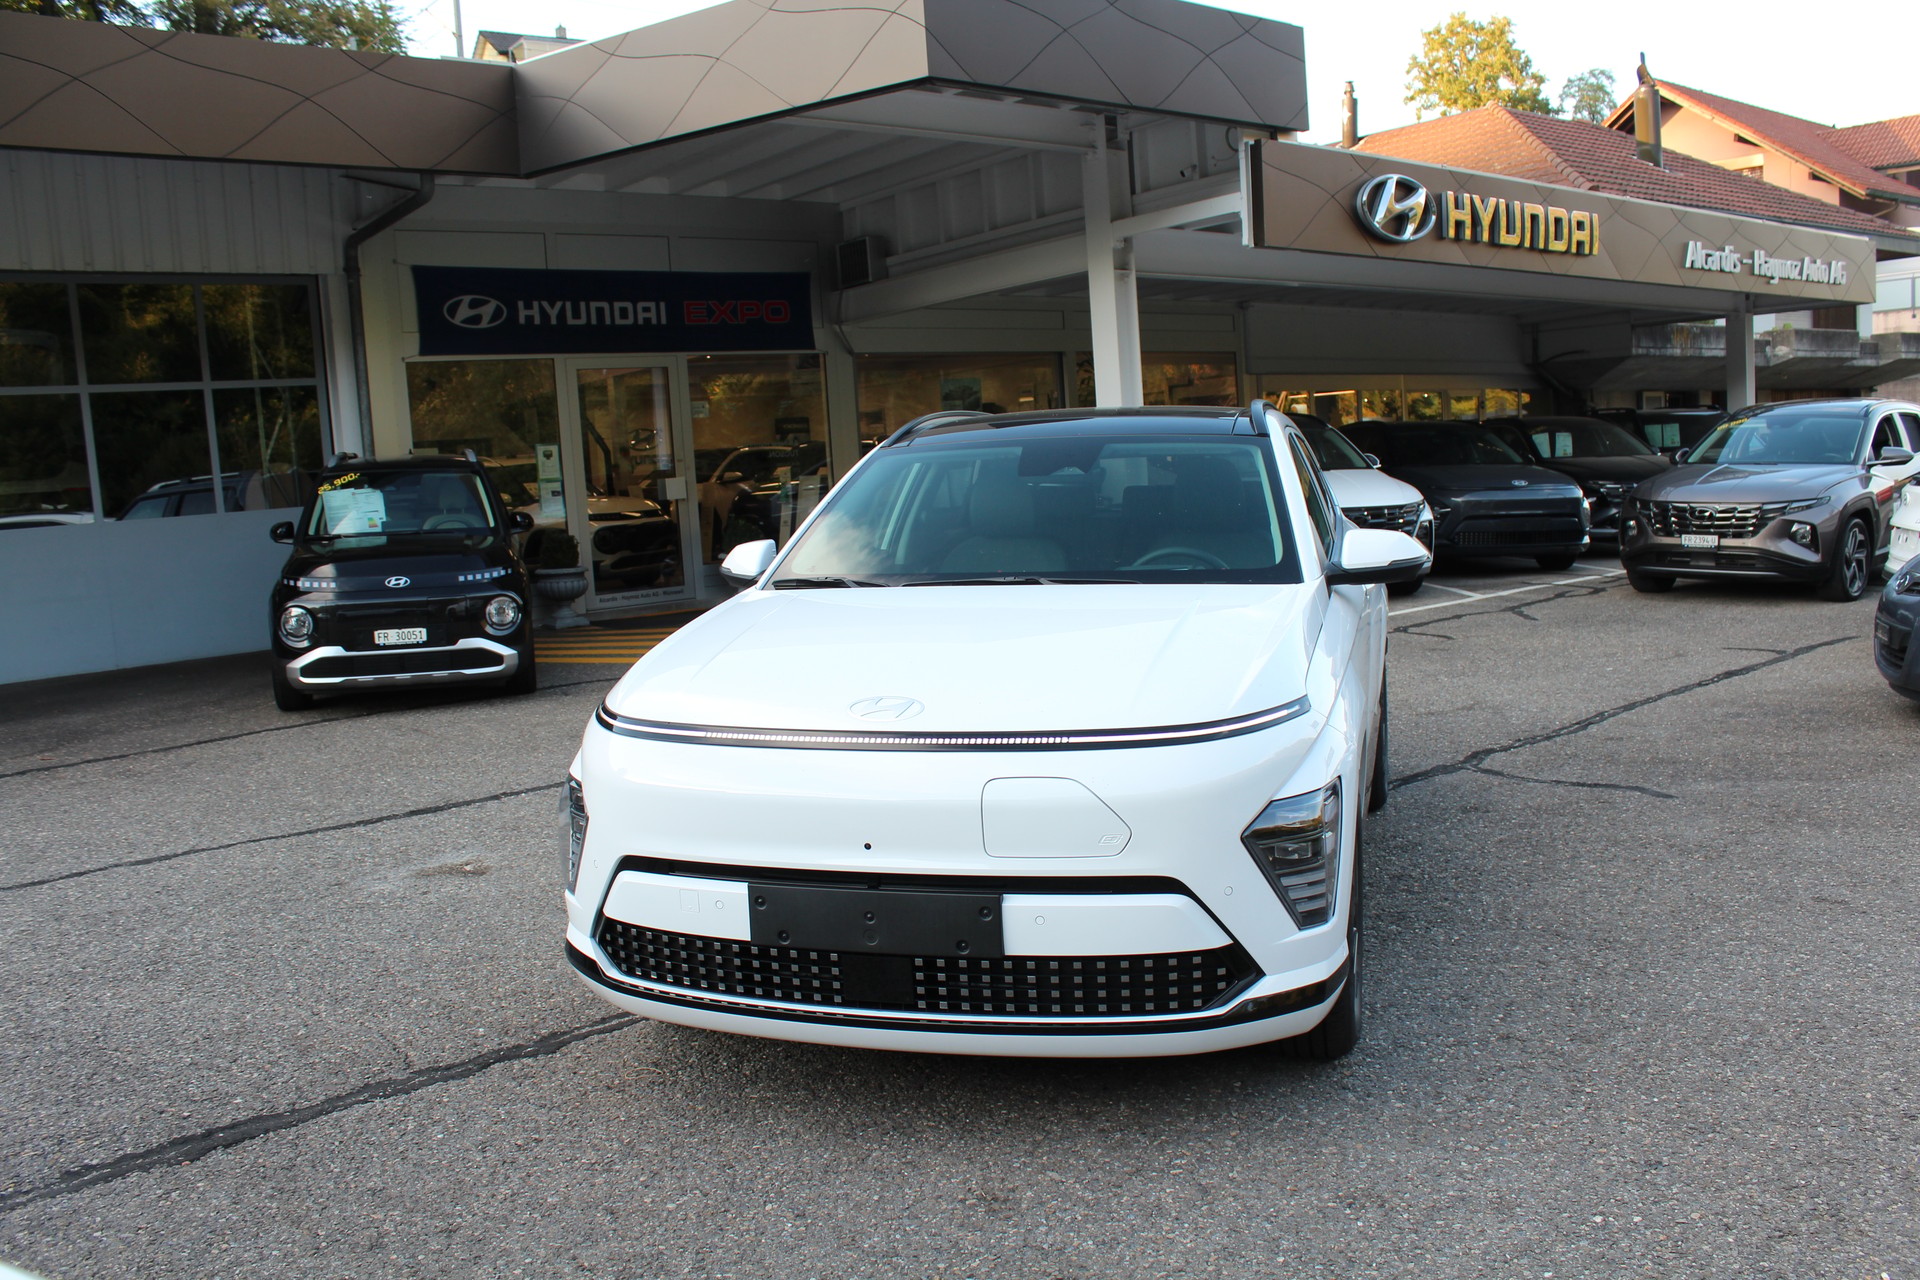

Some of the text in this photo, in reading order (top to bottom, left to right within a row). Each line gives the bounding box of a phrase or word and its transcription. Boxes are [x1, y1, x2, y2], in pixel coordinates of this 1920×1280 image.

[1442, 190, 1599, 256] HYUNDAI
[1685, 240, 1741, 273] Alcardis
[1753, 249, 1802, 285] Haymoz
[1802, 256, 1829, 284] Auto
[1829, 260, 1848, 285] AG
[516, 299, 792, 326] HYUNDAI EXPO
[1684, 535, 1693, 544] FR
[377, 630, 424, 643] FR 30051
